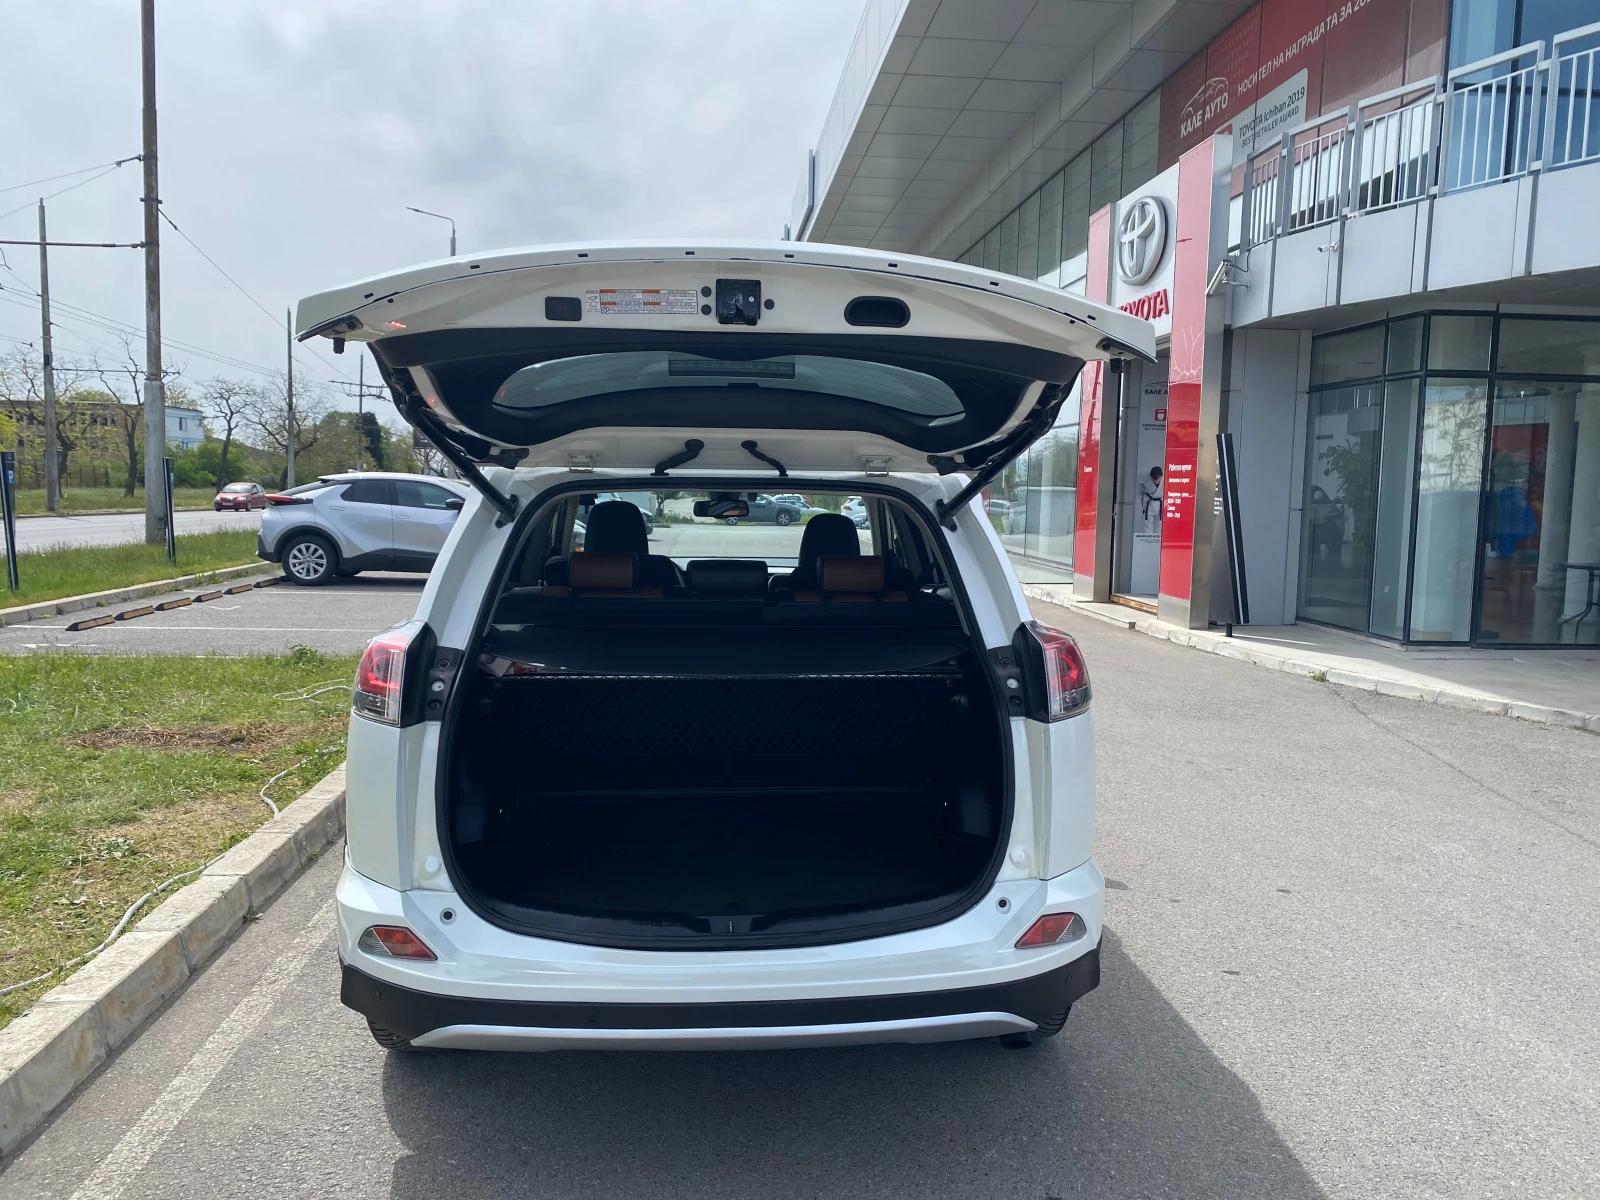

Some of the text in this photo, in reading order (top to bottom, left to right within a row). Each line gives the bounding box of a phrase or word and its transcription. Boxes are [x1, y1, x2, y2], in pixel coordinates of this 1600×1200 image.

[1238, 61, 1272, 96] НОСИТЕЛ
[1272, 53, 1284, 70] НА
[1339, 1, 1352, 21] ЗА
[1180, 92, 1229, 138] КАЛЕ АУТО
[1239, 86, 1305, 138] TOYOTA Ichiban 2019
[1241, 134, 1254, 148] BEST
[1278, 105, 1299, 125] AWARD
[1117, 288, 1169, 321] YOTA
